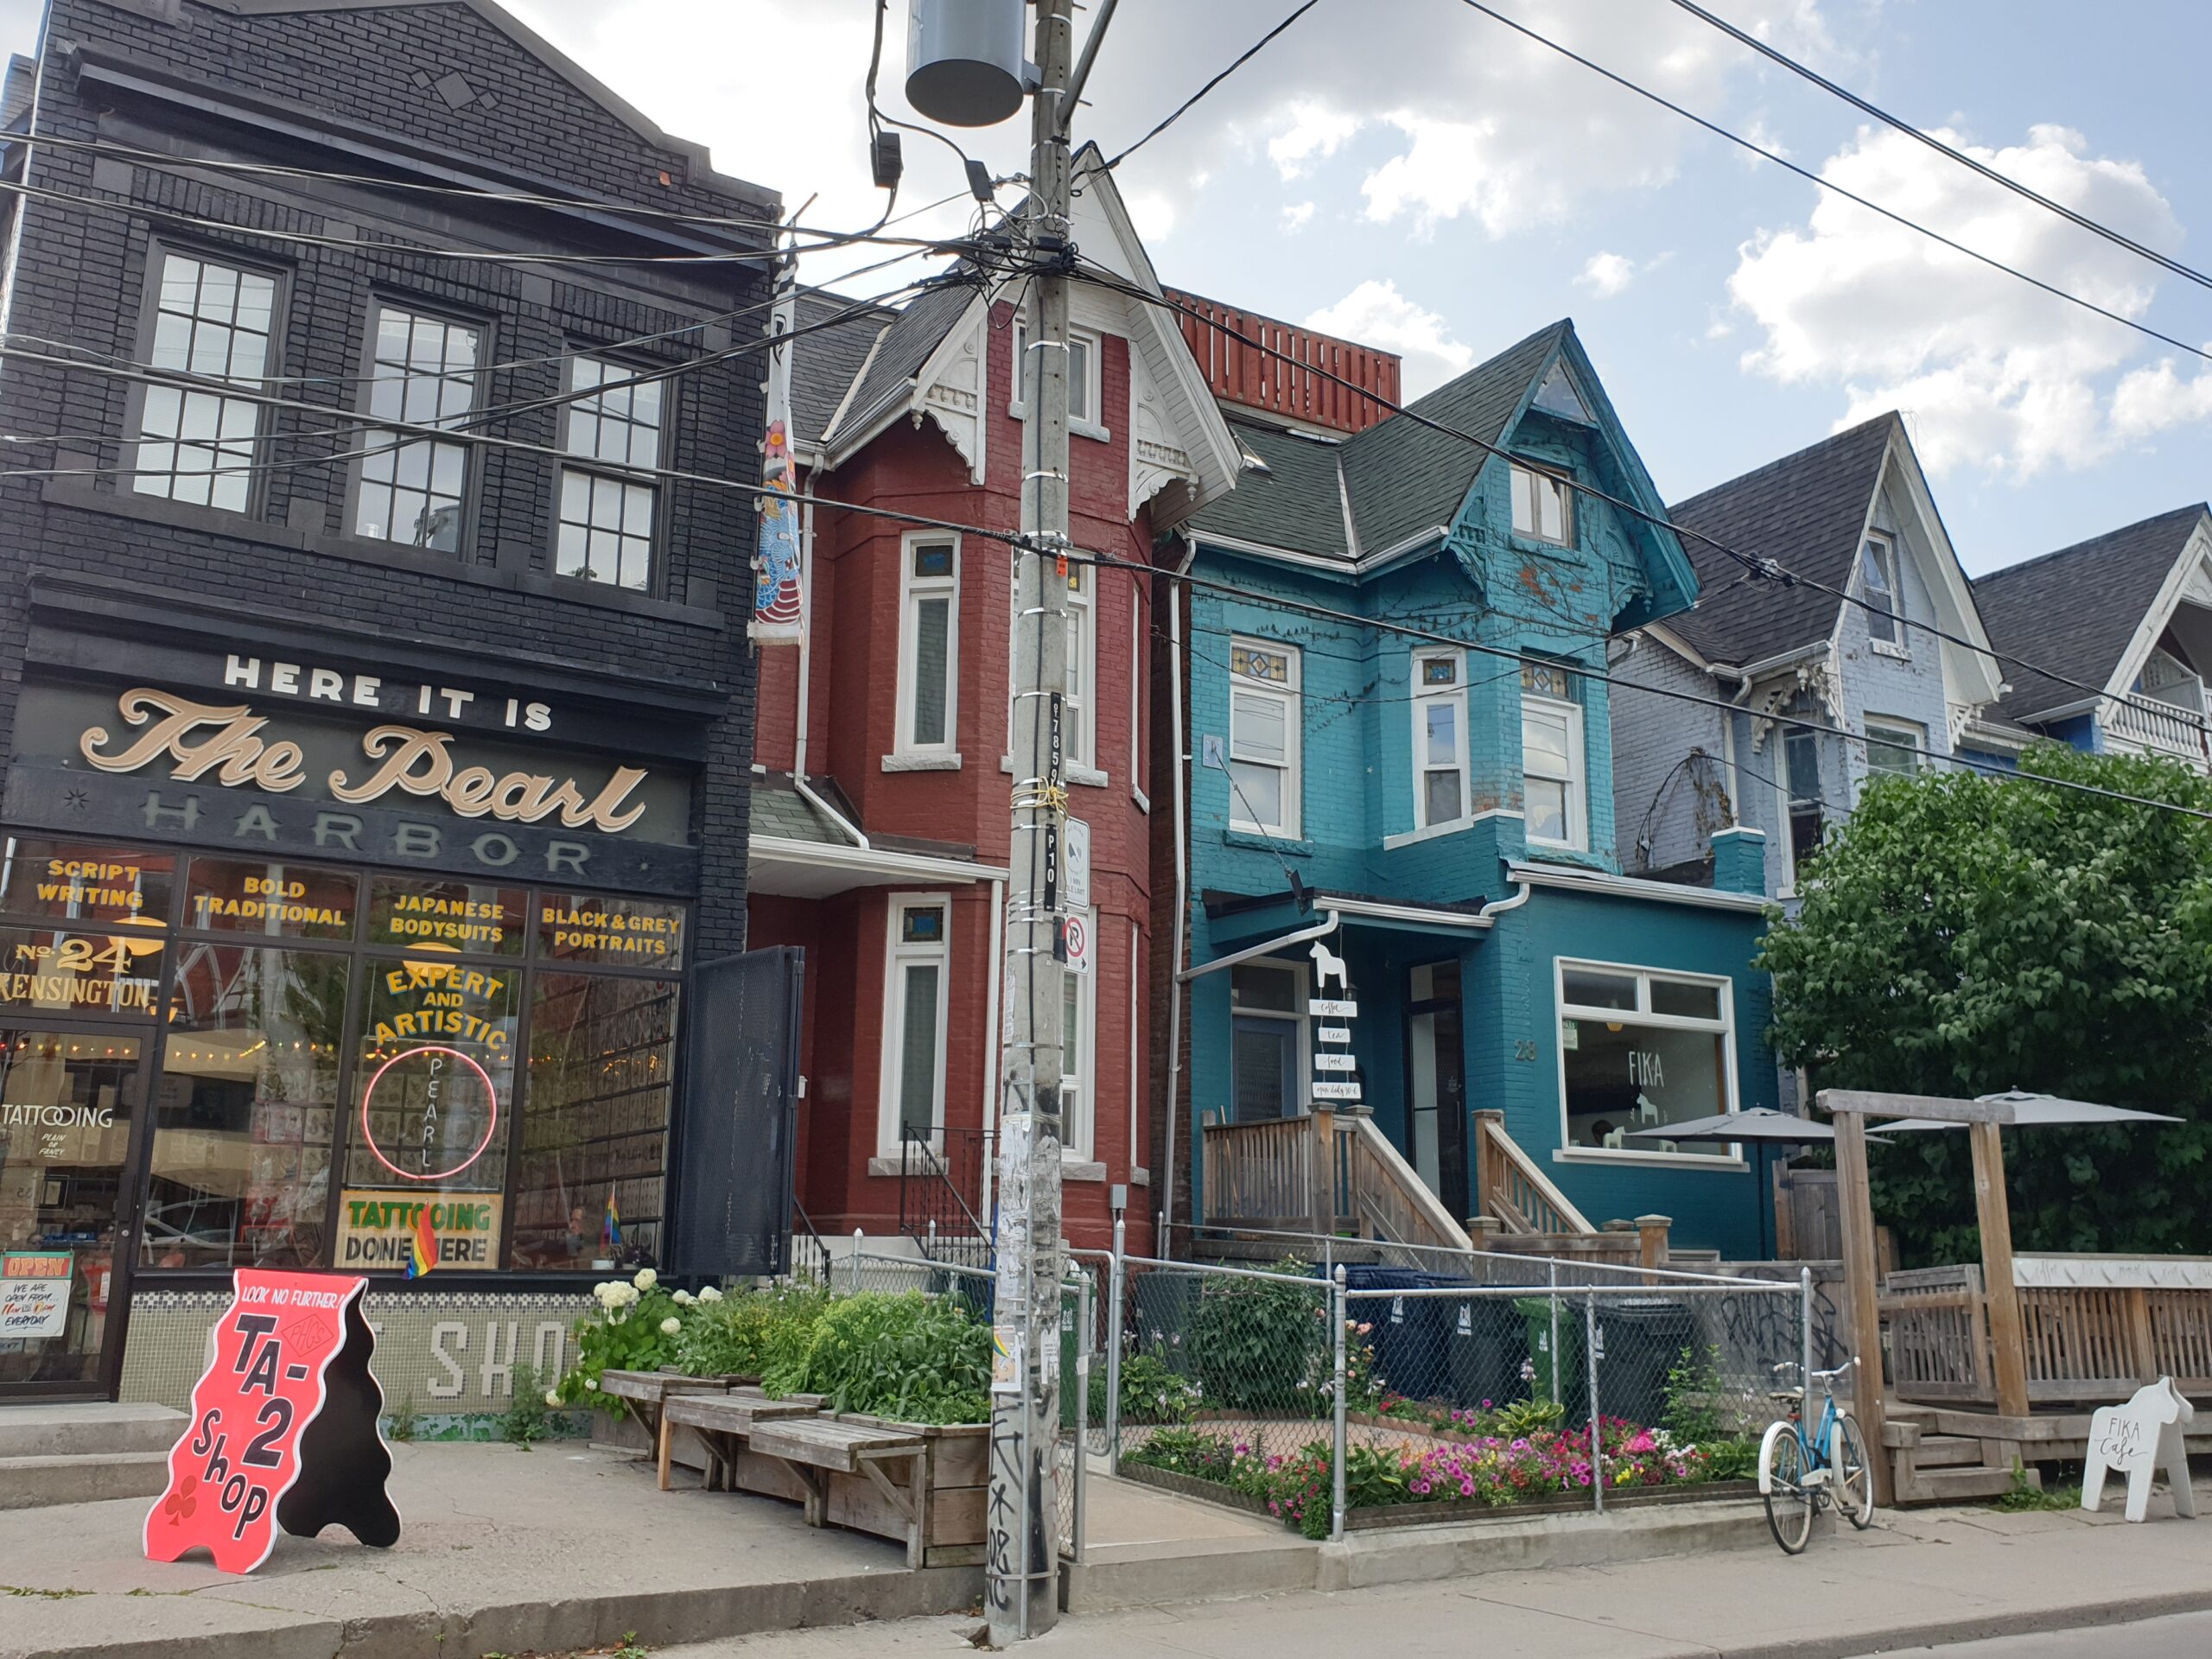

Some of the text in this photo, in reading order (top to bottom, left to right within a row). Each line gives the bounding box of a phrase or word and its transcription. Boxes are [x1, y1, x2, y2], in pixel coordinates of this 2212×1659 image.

[224, 654, 552, 731] HERE IT IS
[79, 687, 648, 833] The Pearl
[139, 790, 592, 875] HARBOR
[48, 859, 140, 881] SCRIPT
[37, 883, 143, 907] WRITING
[244, 877, 305, 899] BOLD
[194, 895, 346, 926] TRADITIONAL
[394, 895, 505, 920] JAPANESE
[390, 918, 503, 943] BODYSUITS
[542, 907, 680, 935] BLACK & GREY
[555, 931, 666, 955] PORTRAITS
[56, 938, 131, 974] 24
[386, 967, 504, 1001] EXPERT
[423, 992, 464, 1007] AND
[375, 1010, 507, 1050] ARTISTIC
[1515, 1039, 1535, 1061] 28
[1628, 1051, 1665, 1088] FIKA
[2, 1104, 113, 1128] TATTOOING
[423, 1058, 442, 1166] PEARL
[346, 1236, 412, 1262] DONE
[8, 1257, 64, 1276] OPEN
[5, 1294, 27, 1302] OPEN
[14, 1283, 48, 1294] WE ARE
[241, 1286, 345, 1309] LOOK NO FURTHER!
[5, 1314, 50, 1326] EVERYDAY
[2108, 1417, 2139, 1440] FIKA
[2097, 1436, 2145, 1465] Cafe
